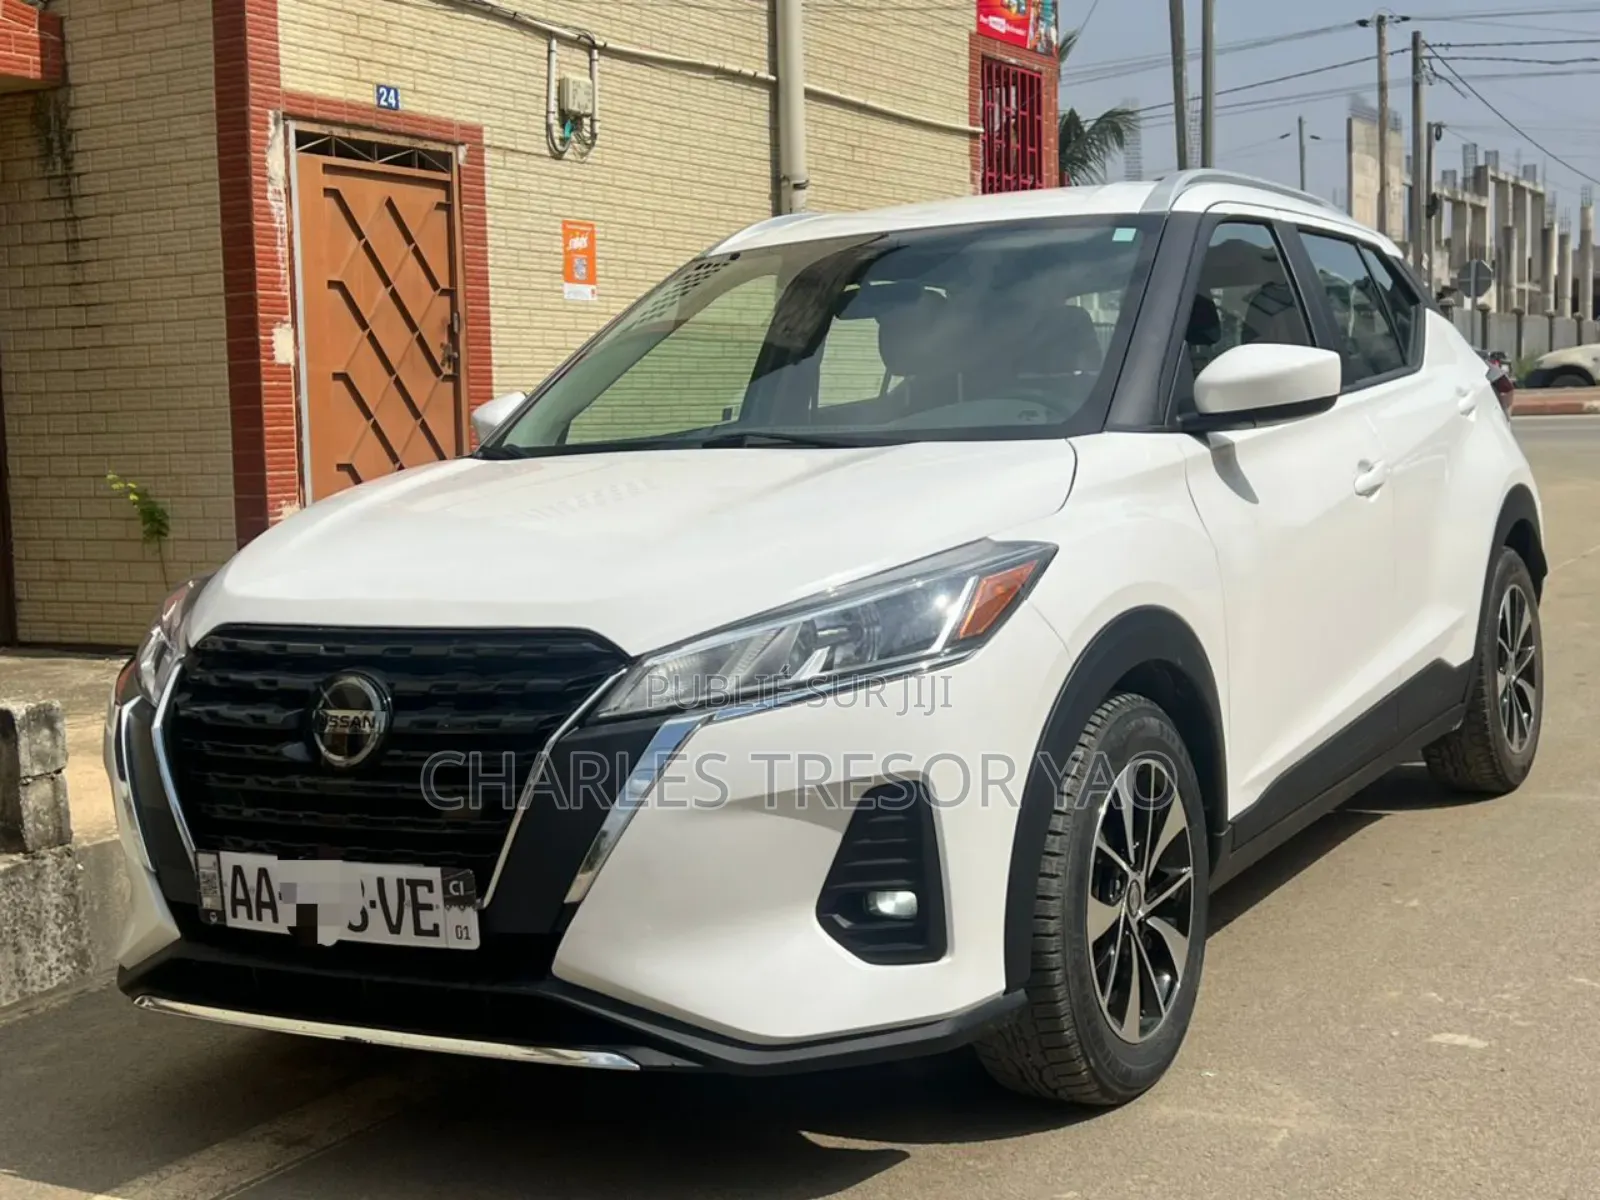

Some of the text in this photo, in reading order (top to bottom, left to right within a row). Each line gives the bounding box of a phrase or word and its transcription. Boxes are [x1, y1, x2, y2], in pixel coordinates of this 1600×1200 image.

[379, 86, 396, 109] 24
[317, 714, 375, 729] ISSAN
[448, 879, 466, 897] CI
[455, 924, 472, 941] 01
